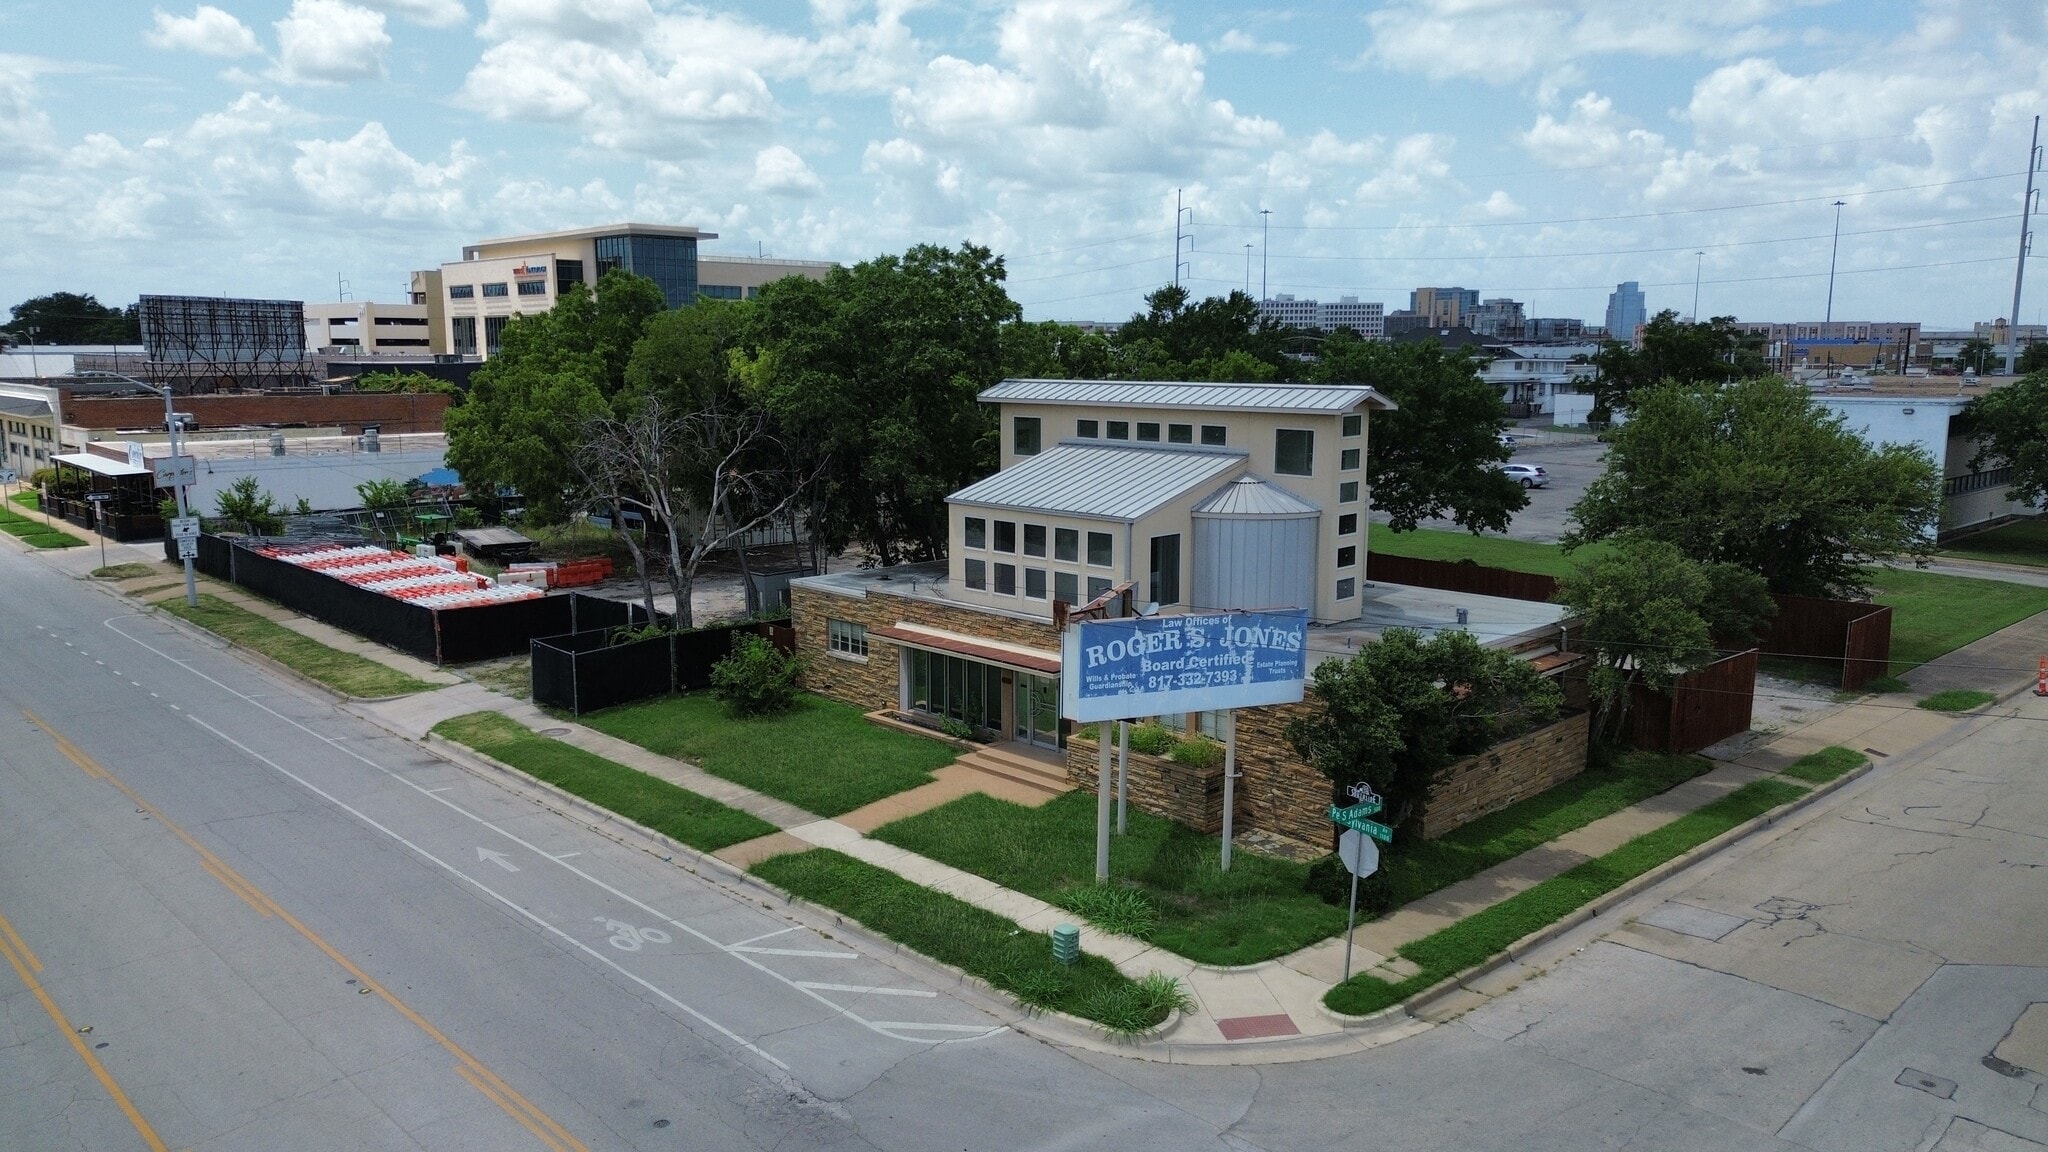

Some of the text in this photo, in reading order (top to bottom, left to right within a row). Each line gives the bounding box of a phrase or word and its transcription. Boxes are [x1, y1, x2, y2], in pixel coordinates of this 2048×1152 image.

[1162, 615, 1232, 627] Law Offices of
[1086, 629, 1182, 668] ROGER
[1219, 626, 1302, 652] JONES
[1141, 652, 1250, 672] Board Certified
[1086, 672, 1136, 682] Wills & Probate
[1148, 669, 1237, 689] 817-332-7393
[1332, 808, 1377, 834] Peylvania
[1342, 812, 1347, 821] S
[1348, 806, 1372, 819] Adams
